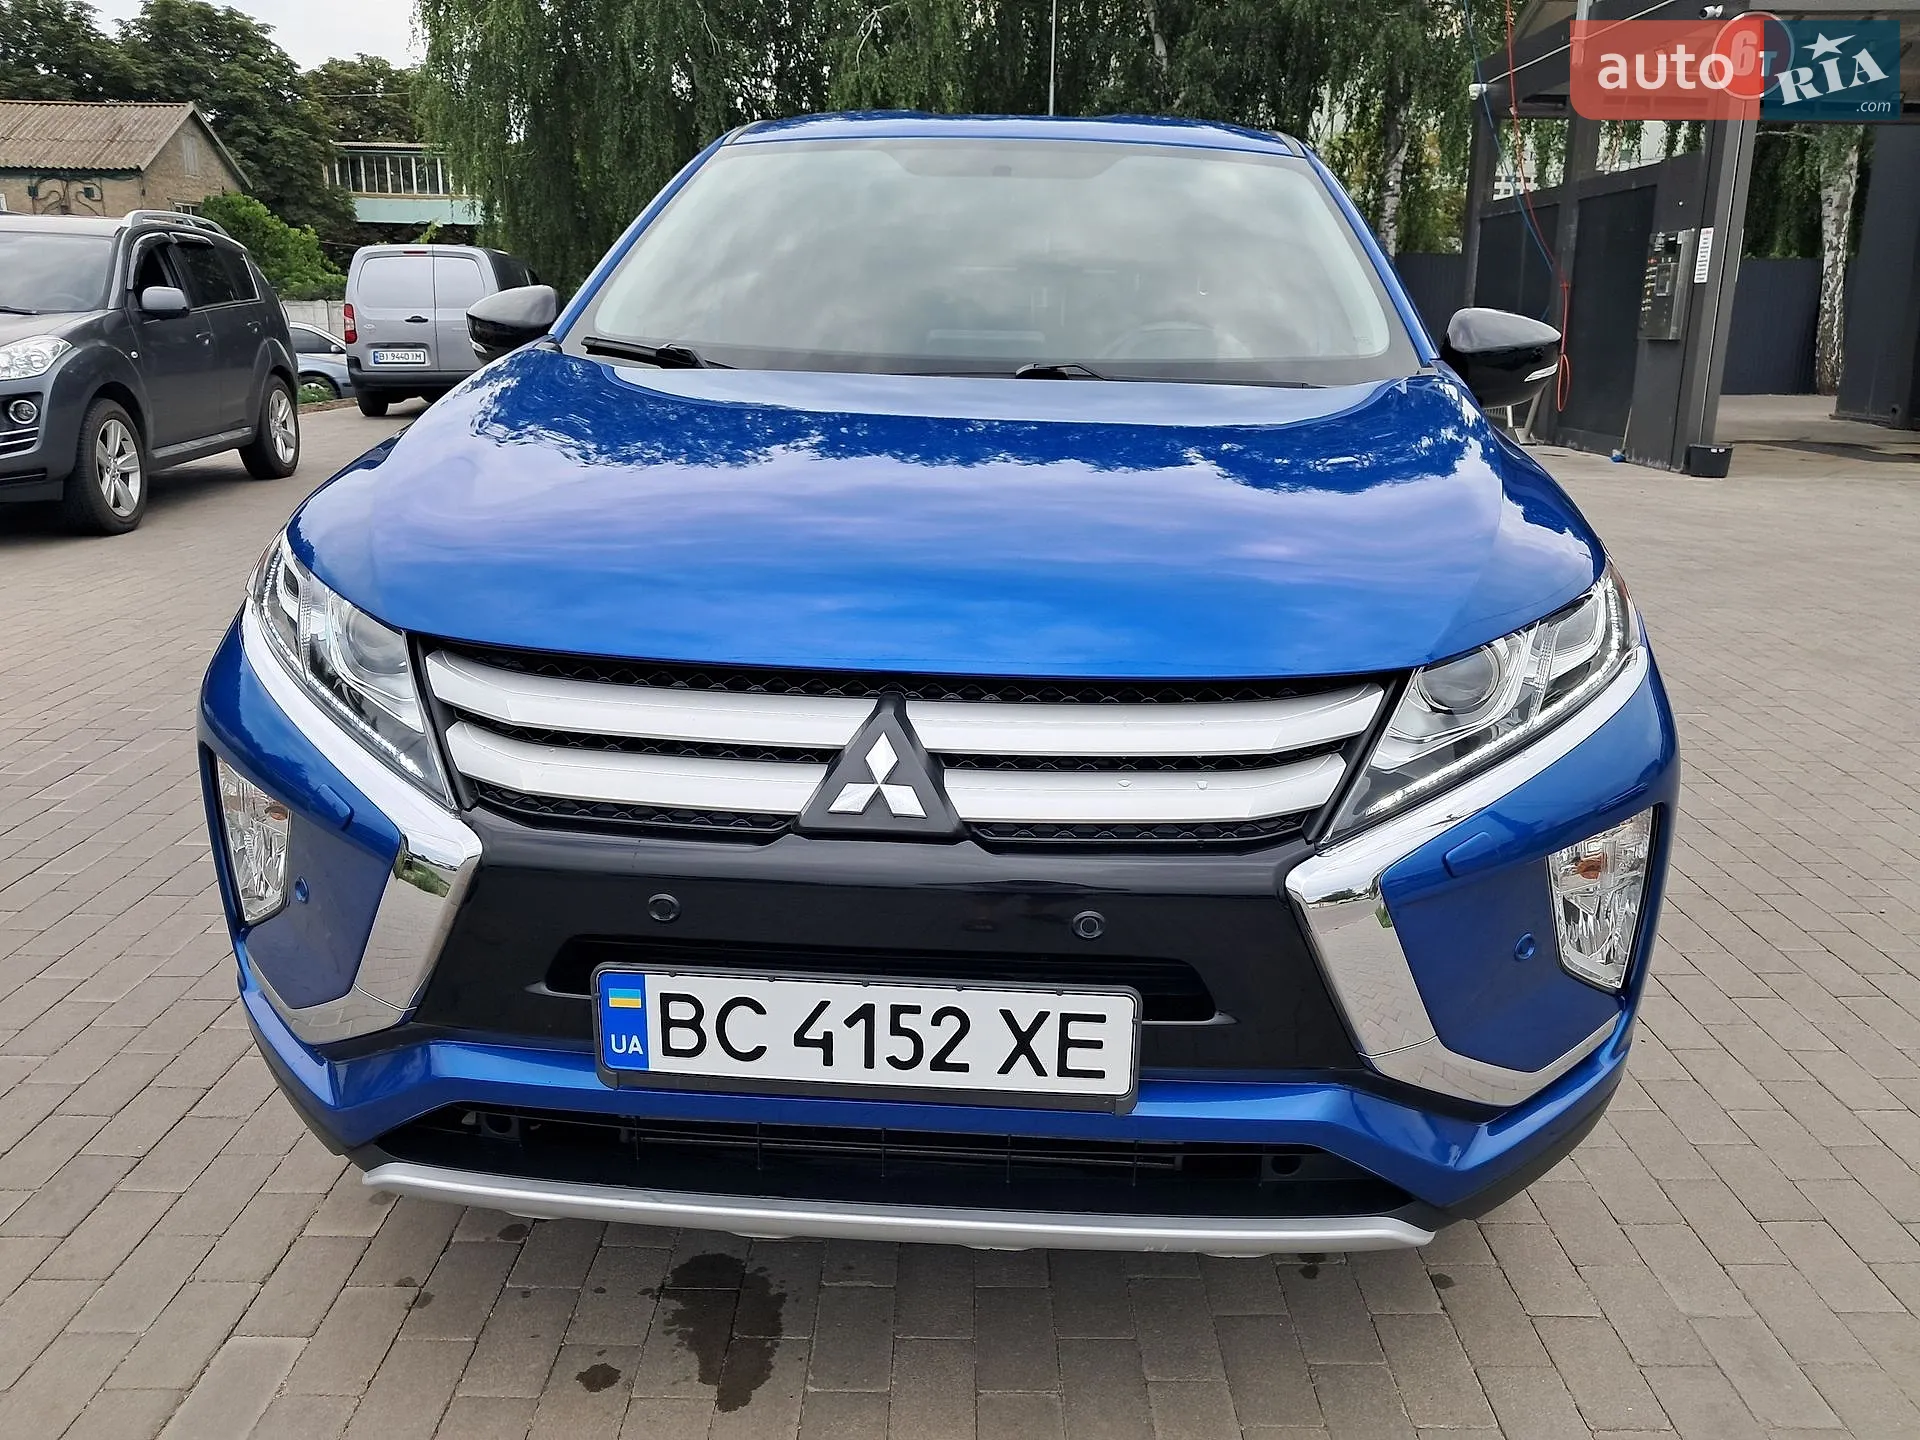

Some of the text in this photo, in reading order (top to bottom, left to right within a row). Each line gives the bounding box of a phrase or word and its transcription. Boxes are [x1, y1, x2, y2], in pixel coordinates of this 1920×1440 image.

[610, 1033, 644, 1055] UA
[659, 992, 1107, 1079] BC 4152 XE
